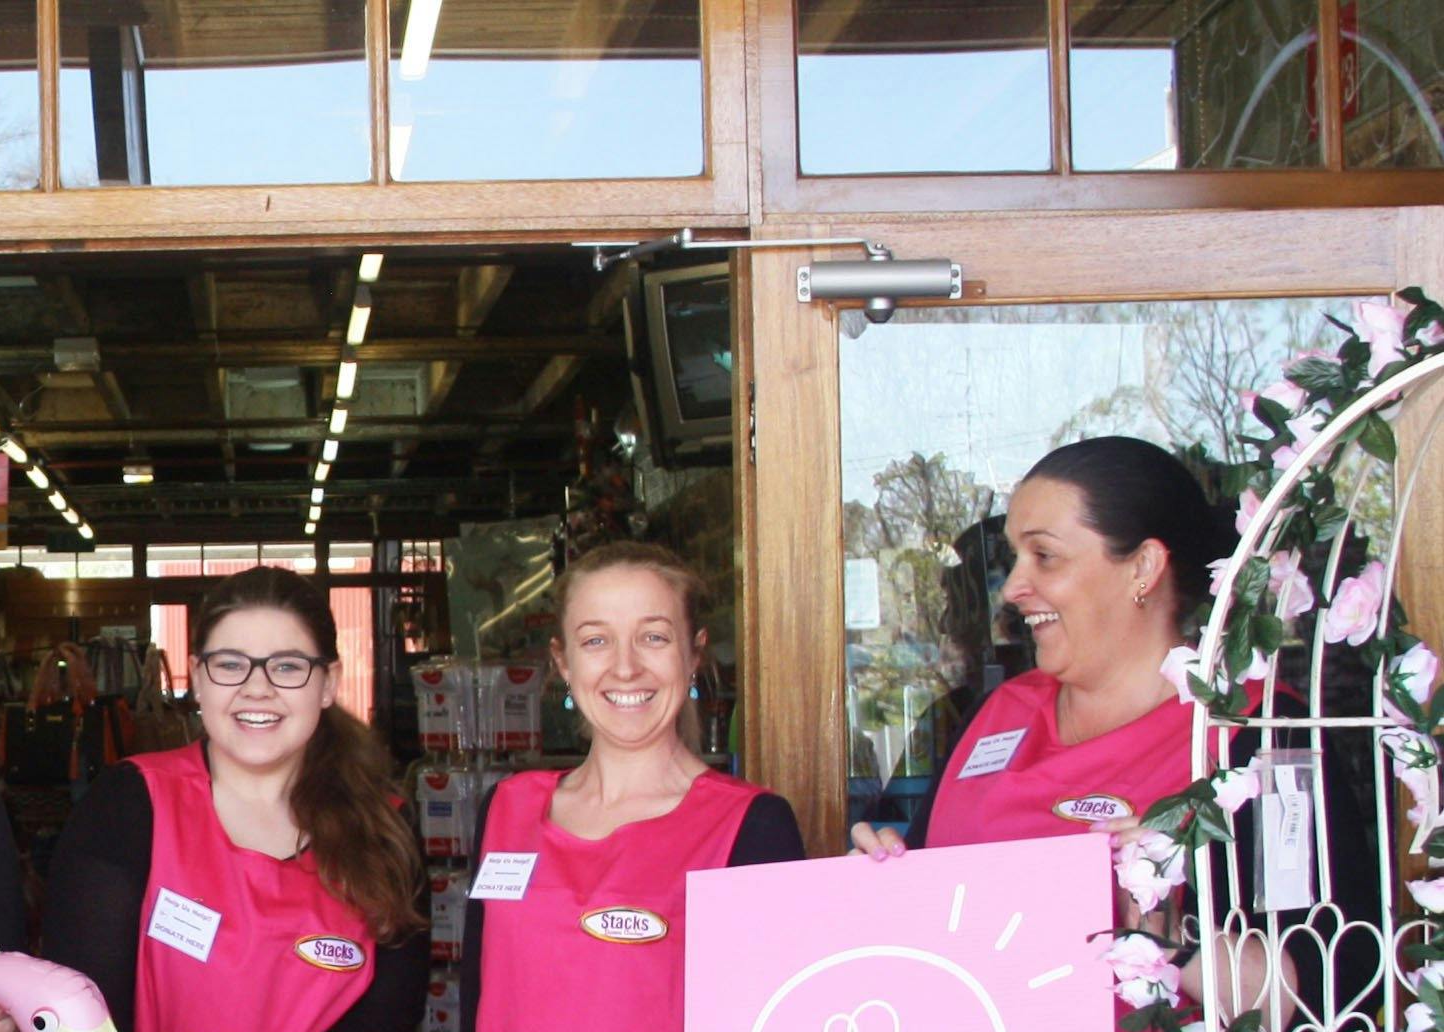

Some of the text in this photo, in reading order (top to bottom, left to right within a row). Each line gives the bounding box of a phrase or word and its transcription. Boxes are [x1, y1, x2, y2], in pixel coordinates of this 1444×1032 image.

[1071, 799, 1117, 816] Stacks
[600, 912, 650, 932] Stacks
[314, 940, 354, 960] Stacks
